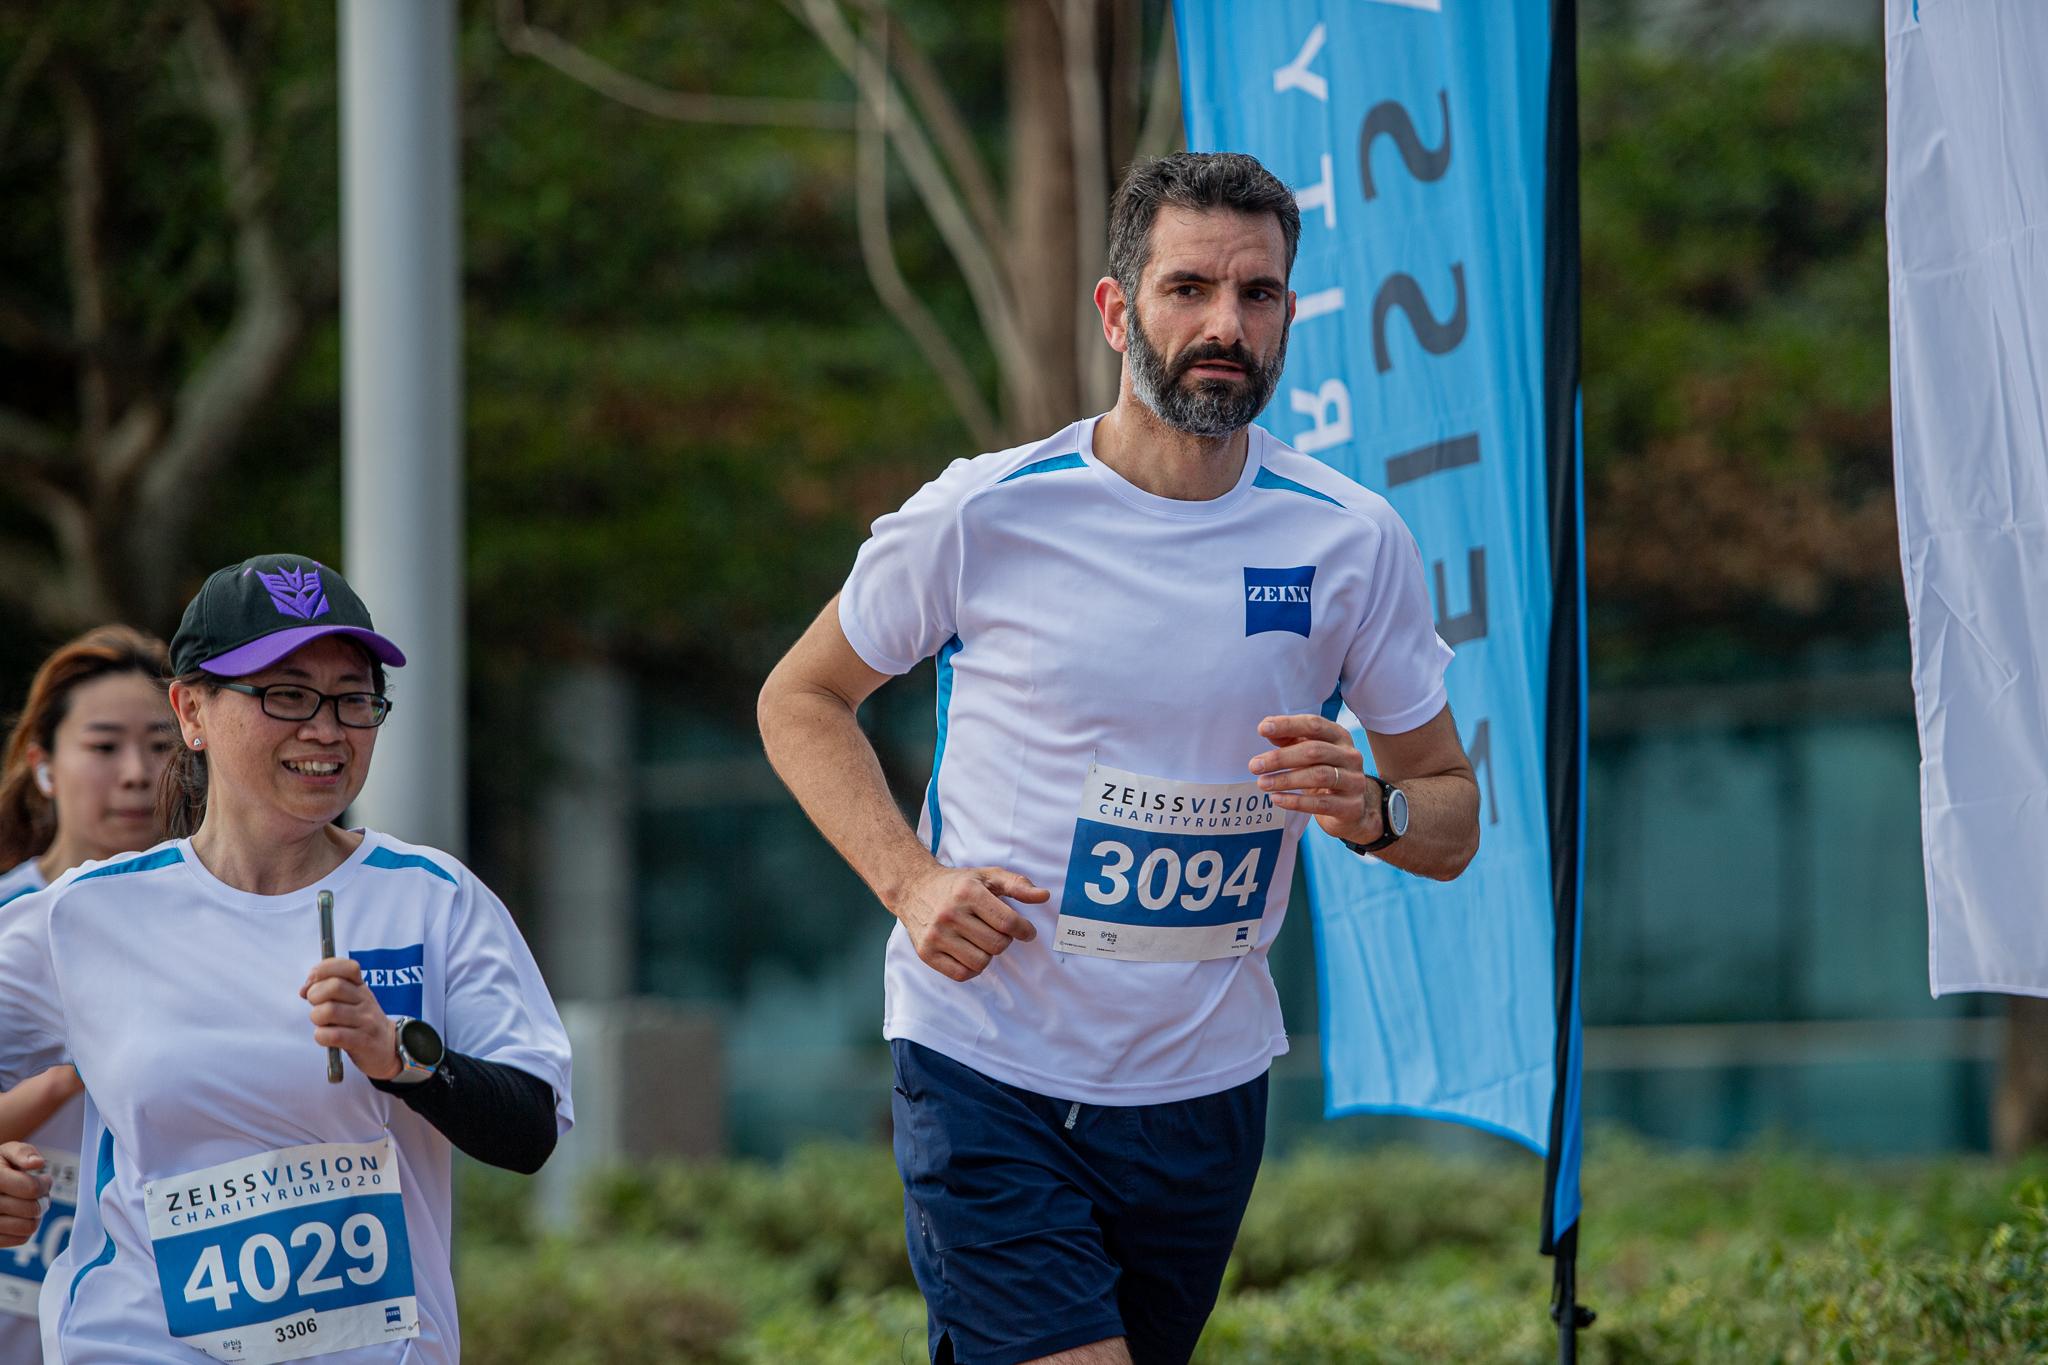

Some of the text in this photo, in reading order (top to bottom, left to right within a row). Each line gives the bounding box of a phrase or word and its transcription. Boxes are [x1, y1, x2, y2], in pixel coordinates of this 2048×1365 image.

[1247, 585, 1309, 603] ZEISS
[1084, 840, 1262, 912] 3094
[183, 1213, 389, 1311] 4029
[274, 1317, 318, 1343] 3306
